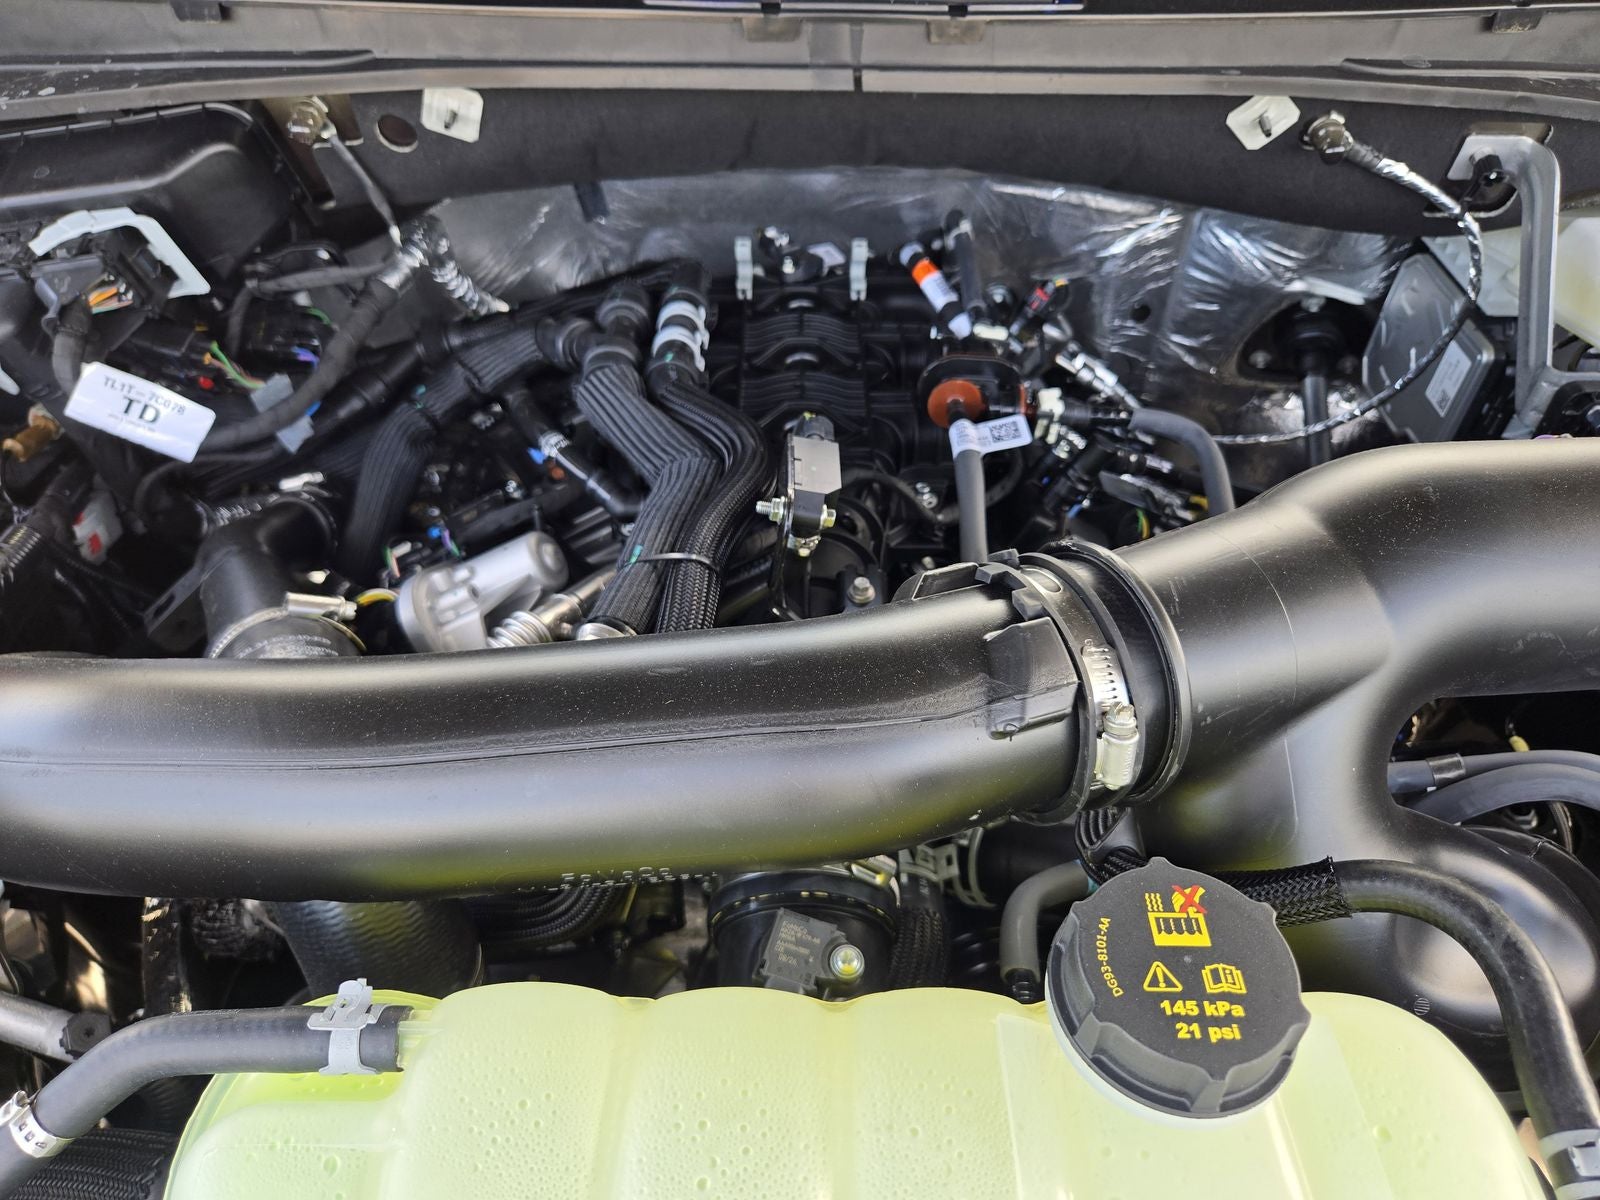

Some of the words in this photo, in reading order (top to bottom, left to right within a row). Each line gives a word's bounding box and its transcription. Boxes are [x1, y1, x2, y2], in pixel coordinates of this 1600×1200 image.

[123, 396, 162, 424] TD
[1096, 917, 1124, 998] DG93-8101-AA
[1160, 999, 1200, 1016] 145
[1203, 1000, 1246, 1017] kPa
[1175, 1021, 1202, 1039] 21
[1208, 1023, 1242, 1044] psi
